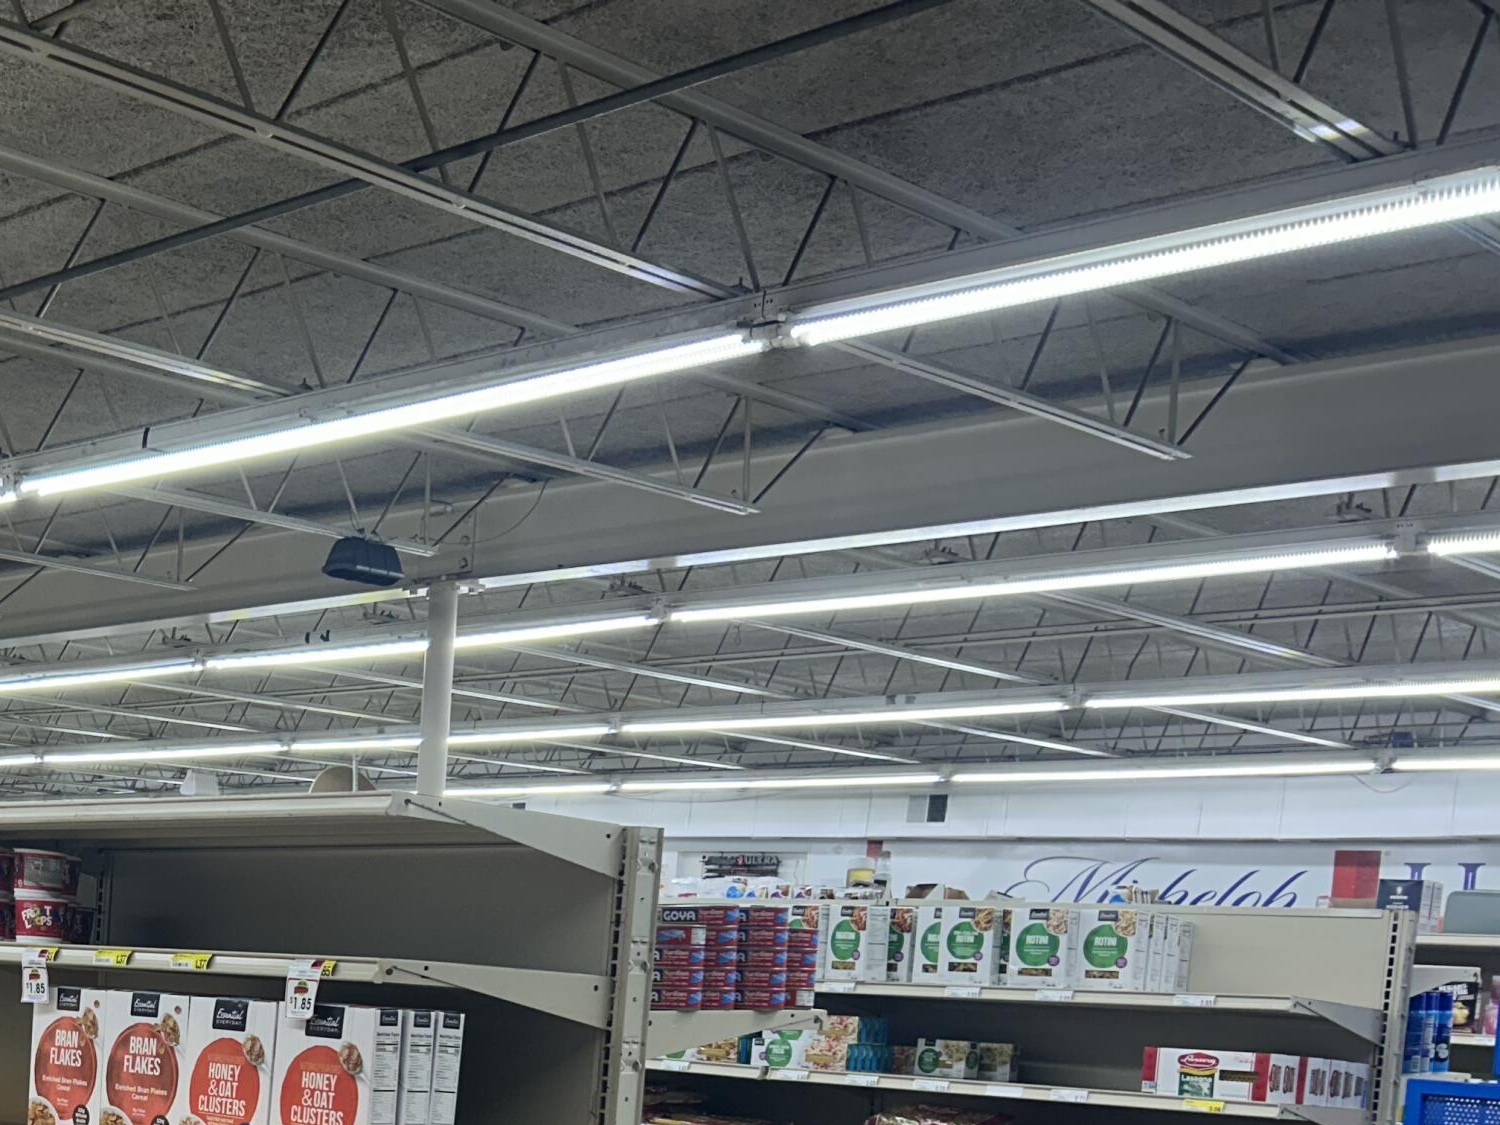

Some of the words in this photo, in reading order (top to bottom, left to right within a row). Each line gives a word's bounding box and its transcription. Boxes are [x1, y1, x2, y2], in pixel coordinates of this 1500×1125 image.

[663, 910, 696, 921] GOYA
[26, 982, 45, 994] $1.85
[289, 995, 312, 1011] $1.85
[216, 1007, 244, 1020] Essential
[55, 1029, 79, 1047] BRAN
[129, 1036, 157, 1055] BRAN
[50, 1048, 82, 1068] FLAKES
[124, 1057, 161, 1076] FLAKES
[208, 1062, 242, 1082] HONEY
[302, 1071, 338, 1092] HONEY
[198, 1095, 246, 1117] CLUSTERS
